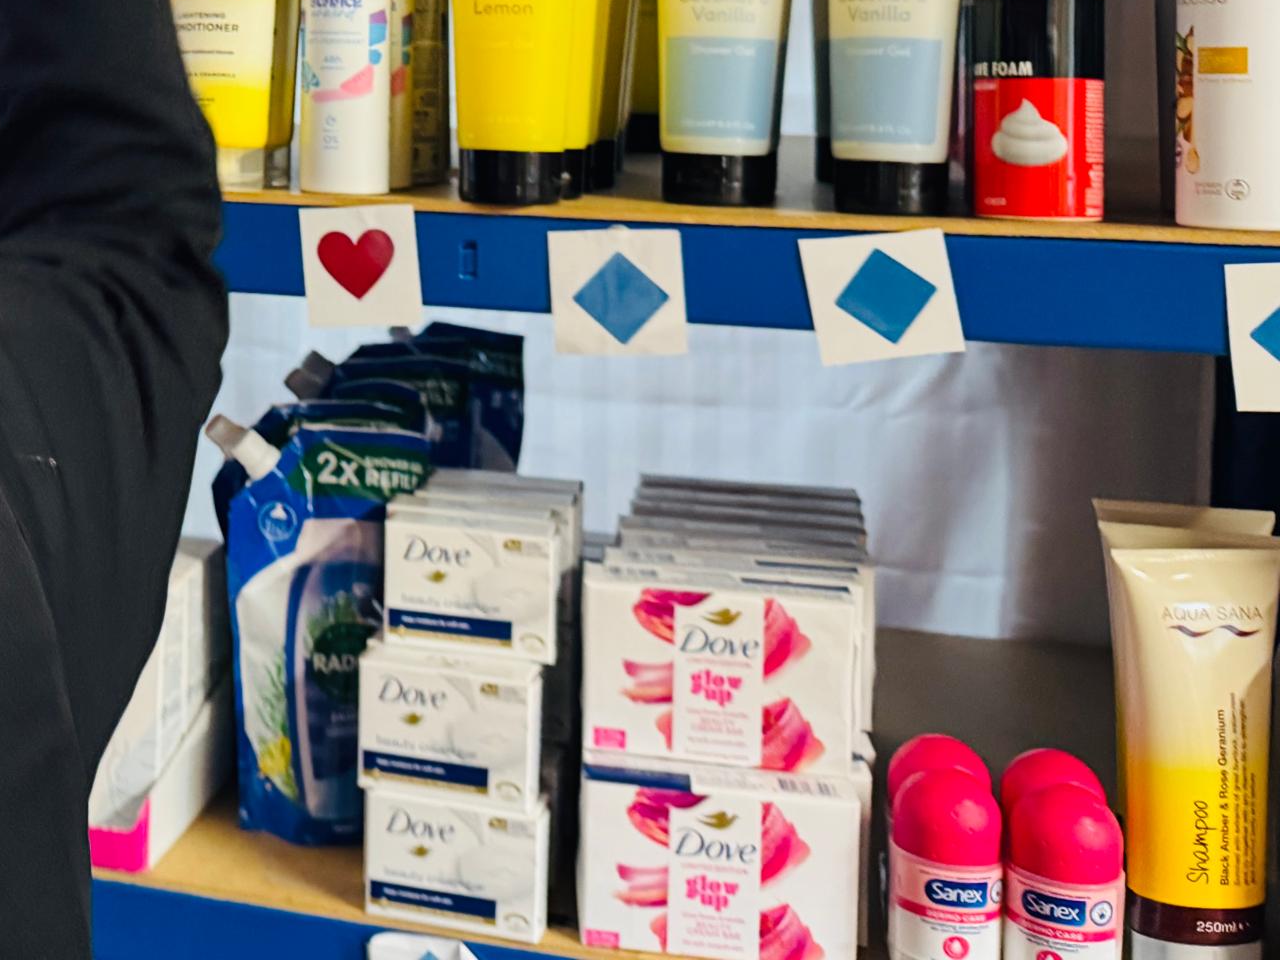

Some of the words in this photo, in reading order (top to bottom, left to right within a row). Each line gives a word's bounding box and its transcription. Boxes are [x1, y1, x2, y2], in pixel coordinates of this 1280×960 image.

[473, 0, 534, 15] Lemon
[992, 60, 1034, 77] FOAM
[402, 533, 471, 567] Dove
[1161, 605, 1210, 622] AQUA
[1216, 606, 1264, 621] SANA
[679, 623, 760, 659] Dove
[313, 652, 360, 674] RAD
[378, 674, 447, 709] Dove
[691, 669, 742, 694] glow
[704, 686, 733, 708] up
[1216, 709, 1228, 767] Geranium
[1219, 770, 1229, 799] Rose
[1219, 802, 1229, 811] &
[386, 806, 455, 842] Dove
[1220, 814, 1230, 852] Amber
[674, 826, 757, 864] Dove
[1186, 800, 1217, 885] Shampoo
[1220, 855, 1230, 886] Black
[685, 874, 740, 899] glow
[931, 882, 984, 904] Sanex
[700, 893, 730, 912] up
[1026, 893, 1081, 922] Sanex
[1196, 920, 1236, 934] 250ml
